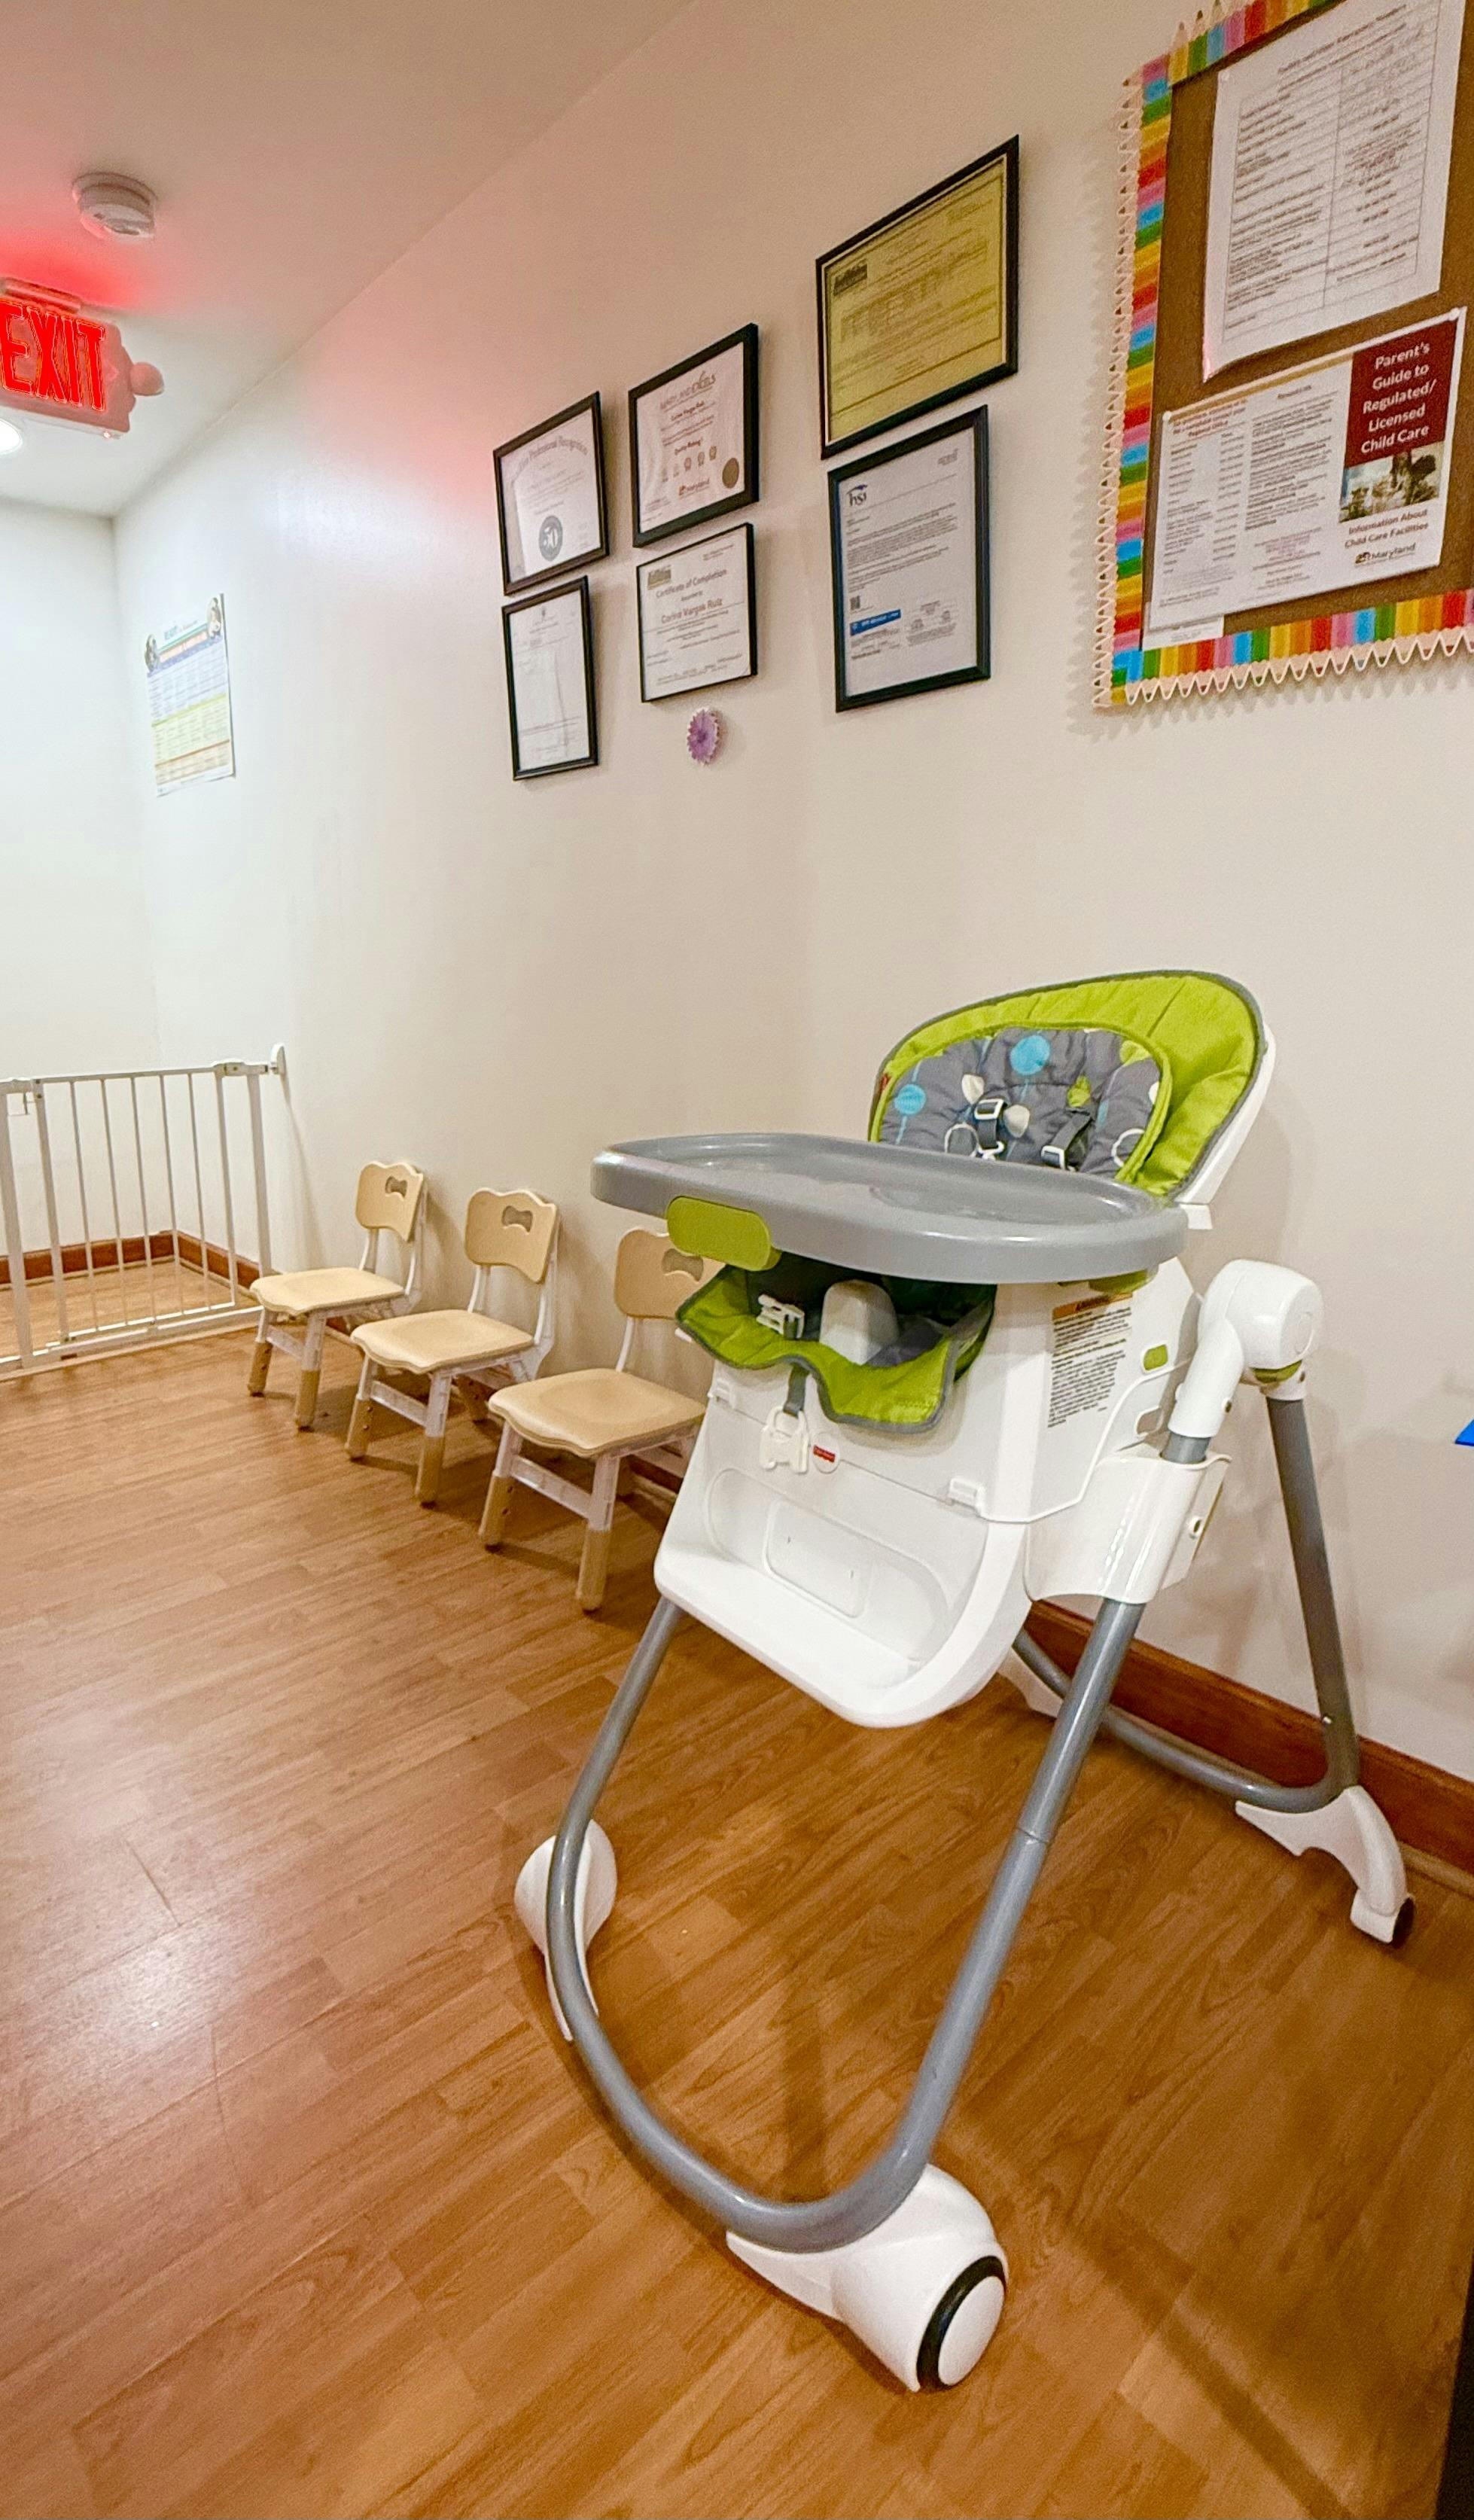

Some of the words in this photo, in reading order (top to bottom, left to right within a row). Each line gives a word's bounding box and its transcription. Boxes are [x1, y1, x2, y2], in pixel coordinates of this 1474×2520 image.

[0, 301, 105, 411] EXIT
[1375, 342, 1430, 370] Parent's
[1372, 369, 1412, 391] Guide
[1415, 364, 1430, 377] to
[1363, 379, 1437, 413] Regulated/
[1369, 403, 1426, 432] Licensed
[1361, 433, 1395, 454] Child
[1397, 425, 1430, 442] Care
[1345, 536, 1366, 549] Child
[1369, 532, 1387, 542] Care
[1390, 523, 1429, 538] Facilities
[1349, 516, 1399, 535] Information
[1401, 509, 1427, 521] About
[656, 584, 684, 598] Certificate
[693, 569, 727, 587] Completion
